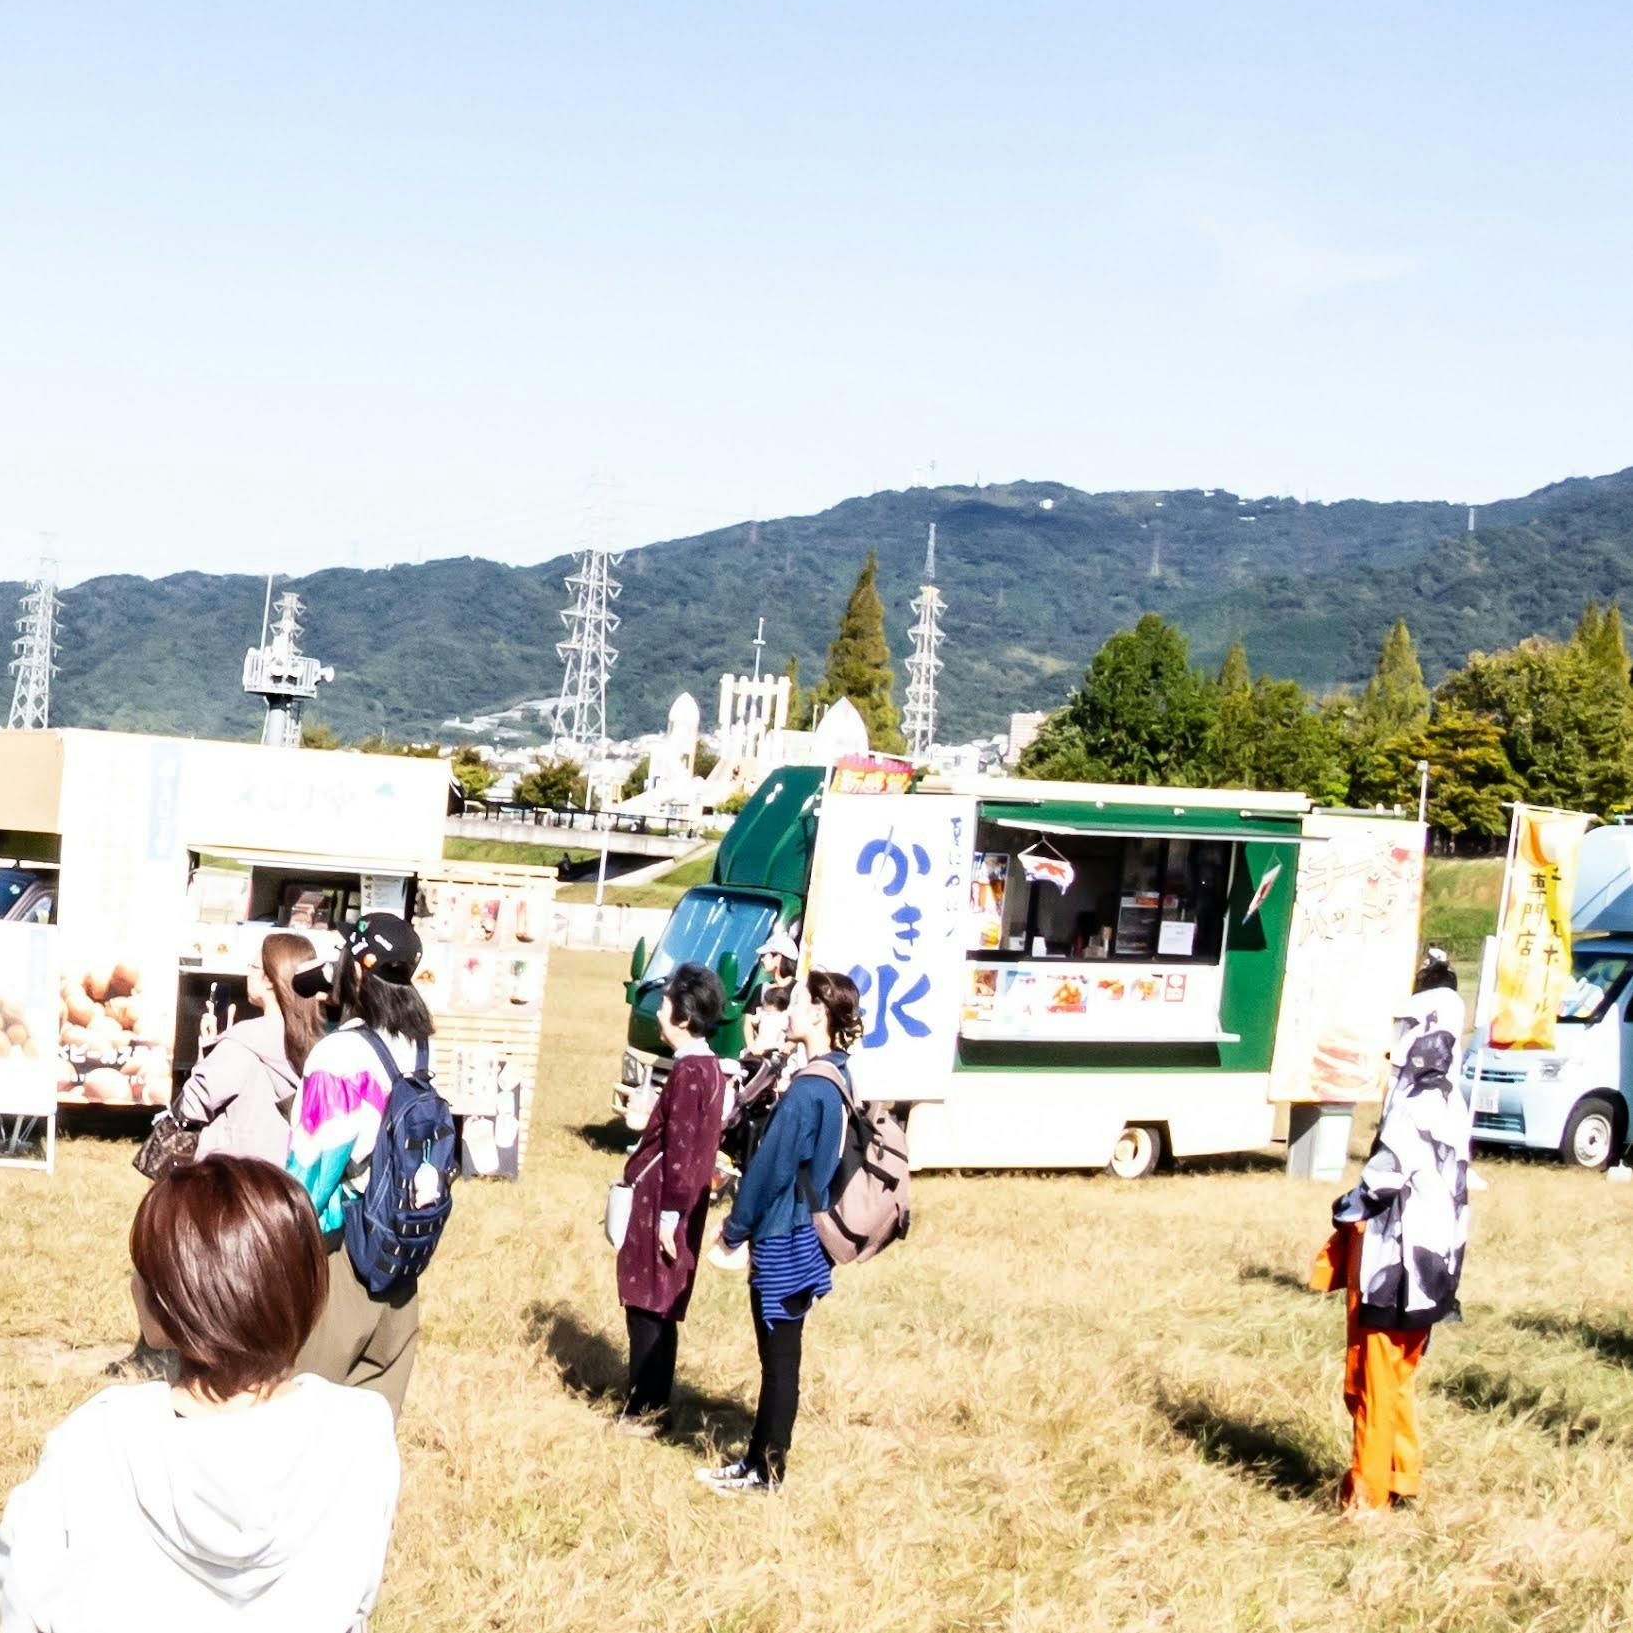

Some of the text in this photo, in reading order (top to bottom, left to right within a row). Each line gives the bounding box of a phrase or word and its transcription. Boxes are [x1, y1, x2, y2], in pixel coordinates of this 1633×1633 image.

[848, 825, 932, 1049] かき氷
[1515, 872, 1548, 957] 専門店
